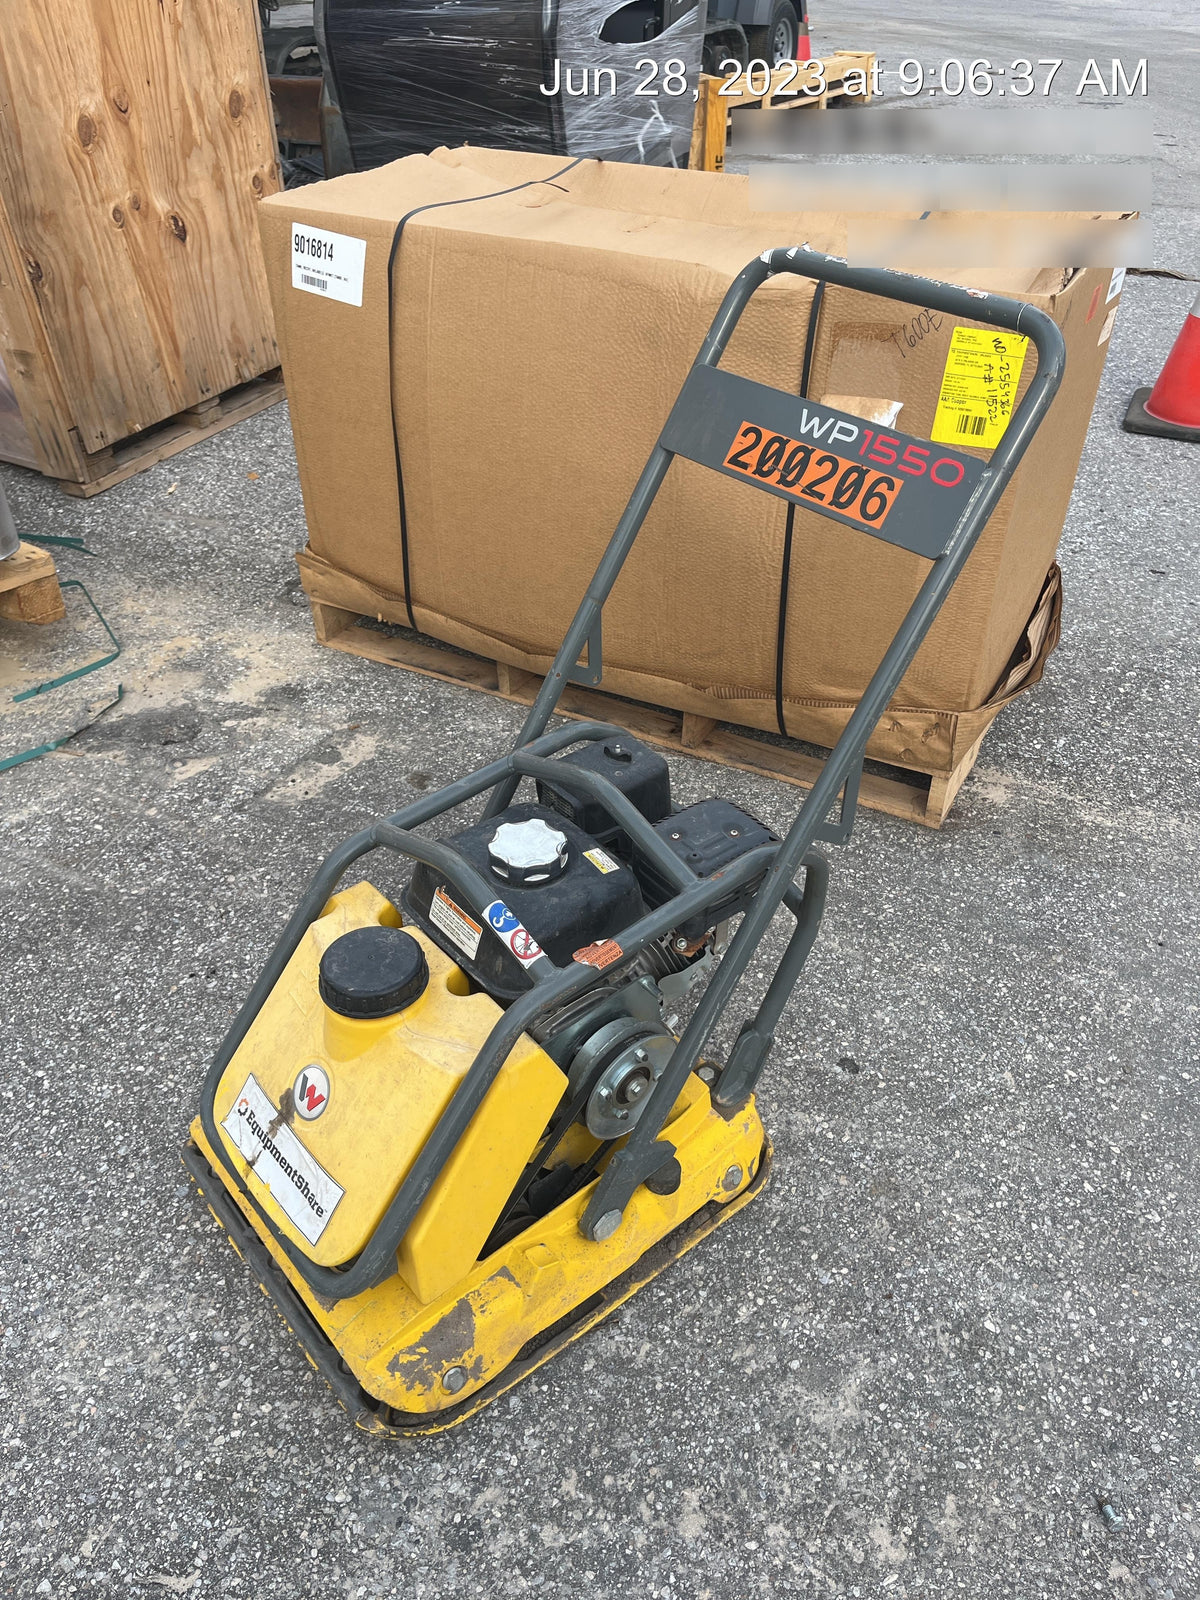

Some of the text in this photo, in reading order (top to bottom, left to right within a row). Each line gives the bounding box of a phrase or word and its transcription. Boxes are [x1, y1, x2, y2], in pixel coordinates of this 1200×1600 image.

[294, 233, 334, 262] 9016814
[881, 308, 944, 359] T600E
[799, 408, 965, 488] WP1550
[246, 1109, 325, 1218] EquipmentShare
